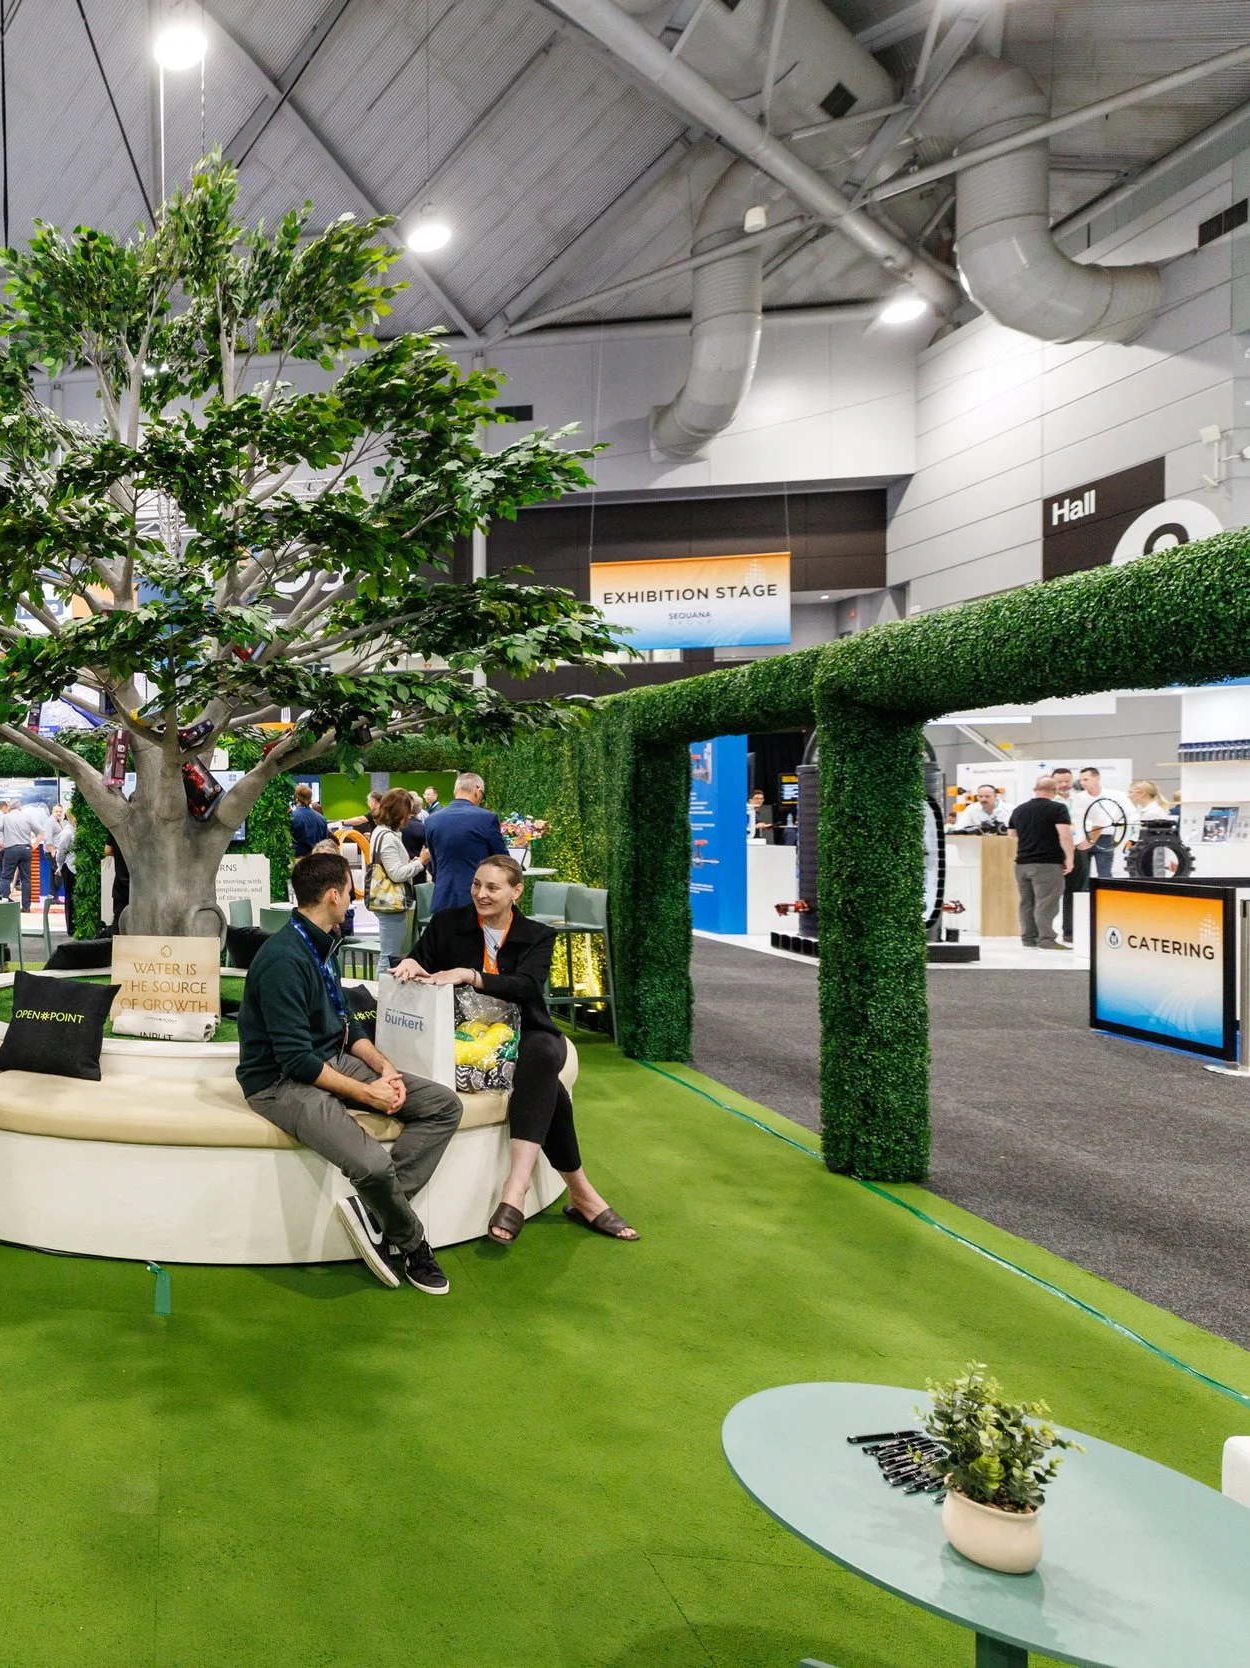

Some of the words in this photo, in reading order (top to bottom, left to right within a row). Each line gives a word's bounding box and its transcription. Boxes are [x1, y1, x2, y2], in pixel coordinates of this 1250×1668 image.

[1052, 489, 1096, 526] Hall
[603, 588, 709, 605] EXHIBITION
[716, 584, 777, 599] STAGE
[668, 611, 711, 620] SEQUANA
[1127, 935, 1215, 960] CATERING
[133, 963, 179, 976] WATER
[187, 963, 197, 976] IS
[123, 980, 147, 993] THE
[152, 980, 207, 994] SOURCE
[120, 997, 137, 1010] OF
[143, 998, 208, 1013] GROWTH
